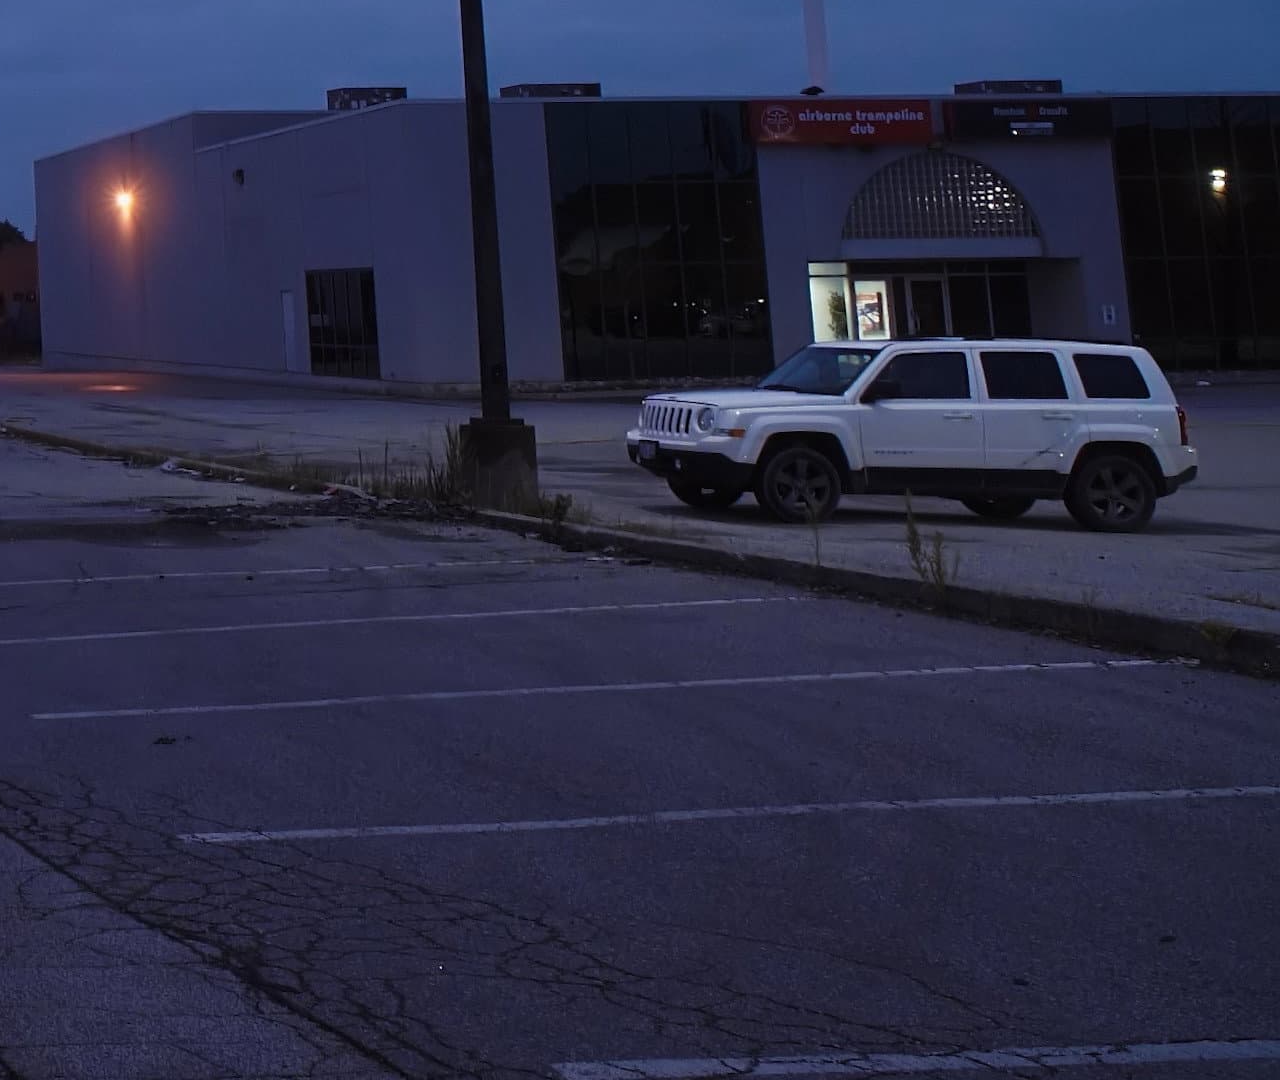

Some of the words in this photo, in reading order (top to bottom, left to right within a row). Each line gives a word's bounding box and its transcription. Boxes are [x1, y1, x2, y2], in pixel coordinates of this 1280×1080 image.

[798, 109, 853, 122] airborne
[855, 108, 925, 124] trampoline
[849, 123, 876, 135] club
